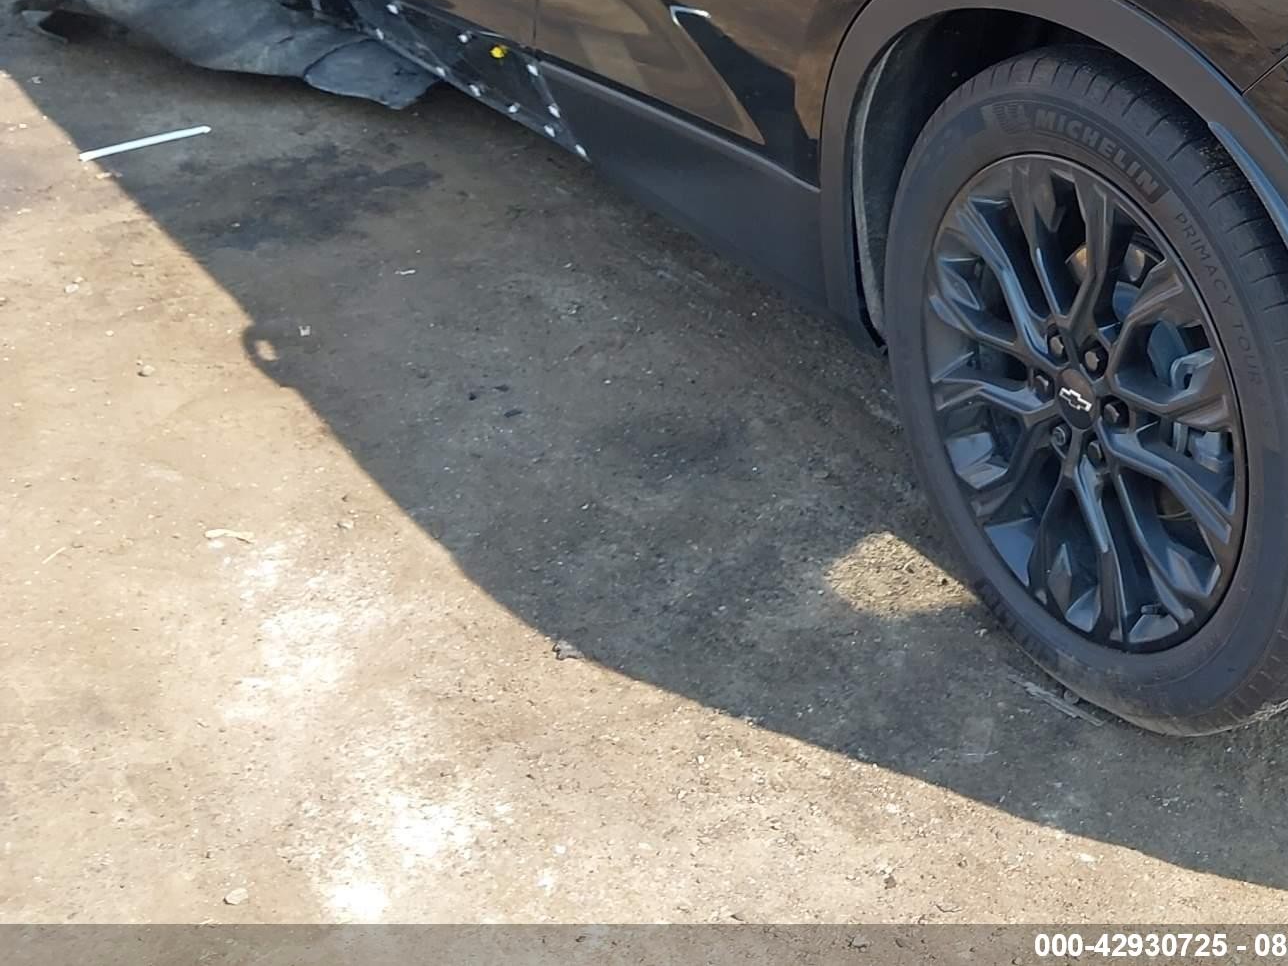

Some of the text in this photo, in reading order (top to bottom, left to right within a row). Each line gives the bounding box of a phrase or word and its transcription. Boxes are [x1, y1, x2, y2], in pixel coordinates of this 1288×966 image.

[1033, 109, 1160, 197] MICHELIN
[1175, 212, 1261, 385] PRIMACY TOUR
